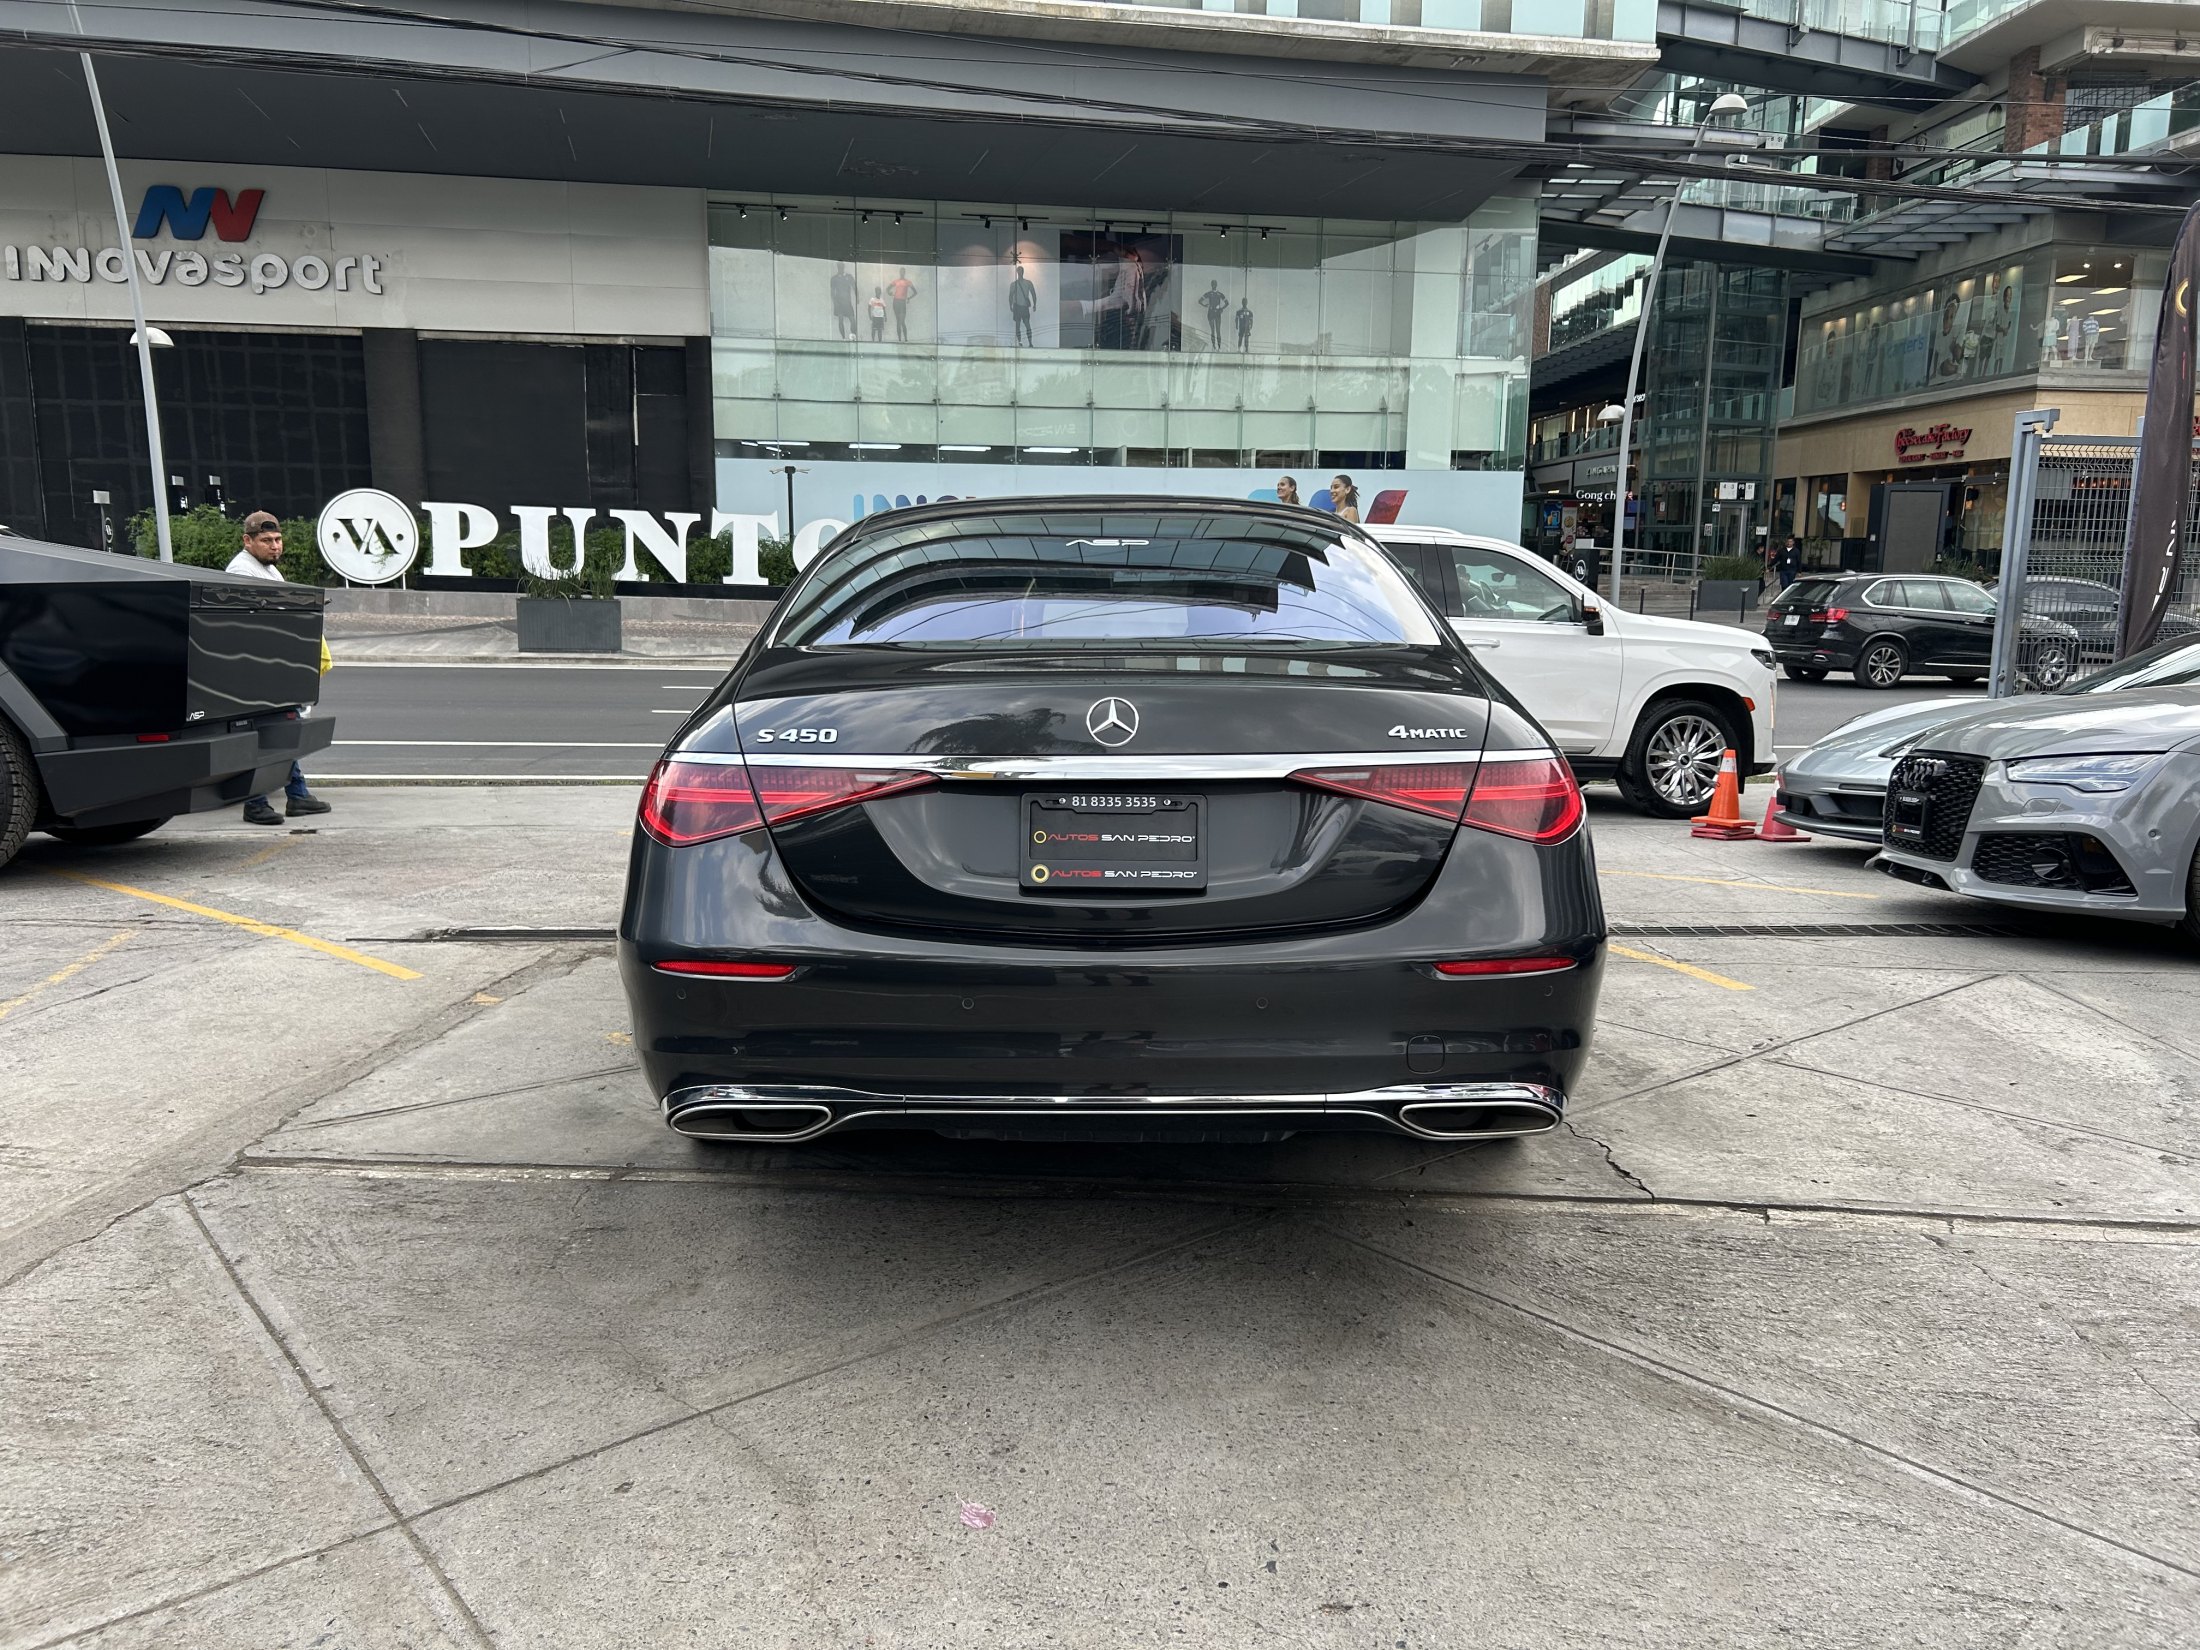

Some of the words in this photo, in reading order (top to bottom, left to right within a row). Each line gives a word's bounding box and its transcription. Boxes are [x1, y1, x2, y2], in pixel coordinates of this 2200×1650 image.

[1576, 489, 1603, 502] Gong
[1604, 490, 1617, 500] ch
[756, 728, 776, 744] S
[778, 728, 839, 744] 450
[1387, 725, 1468, 740] 4MATIC
[1071, 796, 1087, 807] 81
[1090, 796, 1122, 807] 8335
[1125, 797, 1157, 808] 3535
[1048, 833, 1099, 842] AUTOS
[1101, 834, 1135, 842] SAN
[1052, 870, 1102, 878] AUTOS
[1104, 870, 1138, 878] SAN
